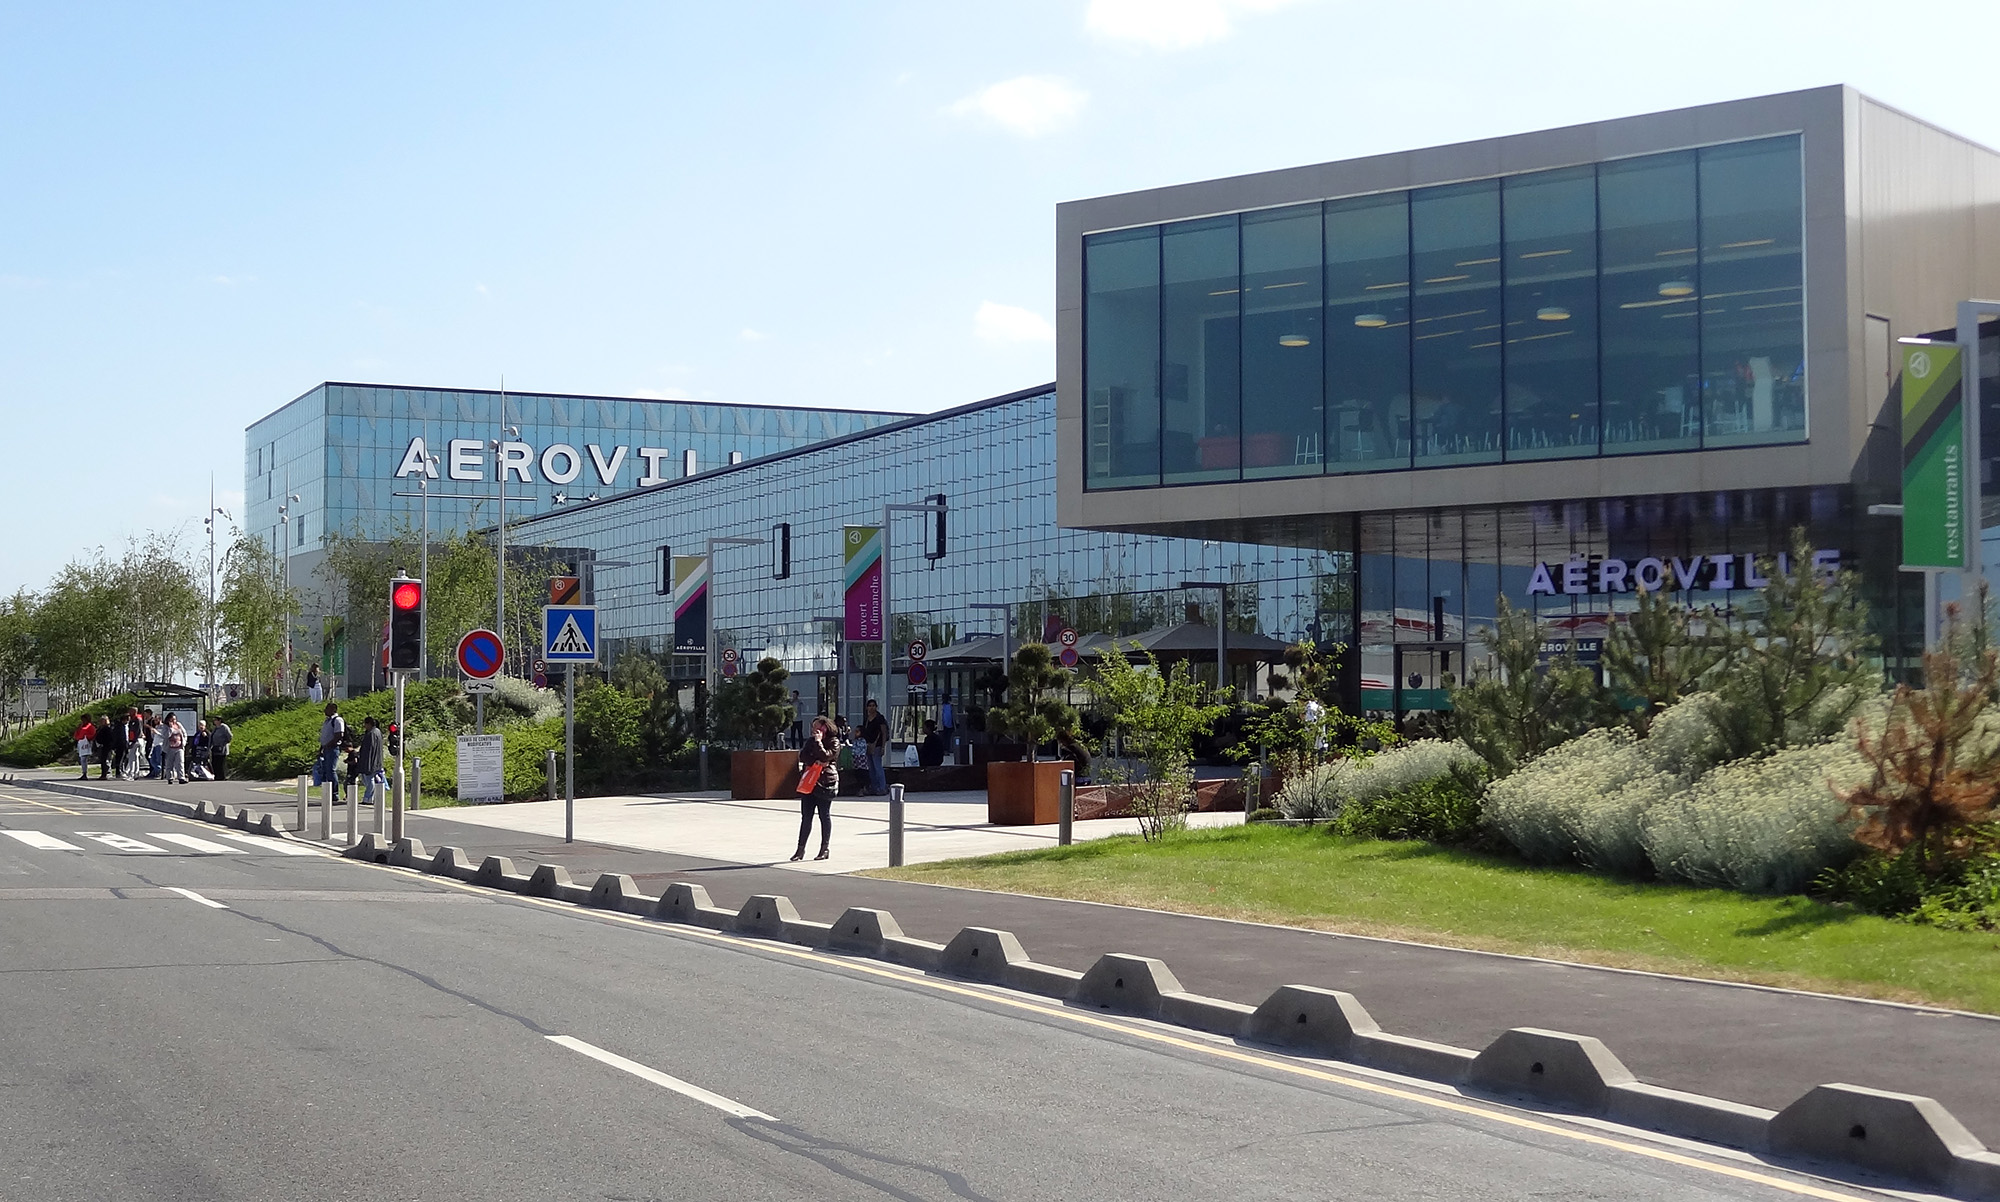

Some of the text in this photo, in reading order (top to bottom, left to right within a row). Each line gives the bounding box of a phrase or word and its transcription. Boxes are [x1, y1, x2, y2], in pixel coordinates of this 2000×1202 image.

[1944, 444, 1959, 560] restaurants
[870, 575, 879, 638] le dimanche
[859, 602, 868, 638] ouvert
[1063, 633, 1074, 642] 30
[912, 646, 923, 656] 30
[1539, 642, 1597, 652] ÉROVLLE
[535, 662, 544, 670] 30
